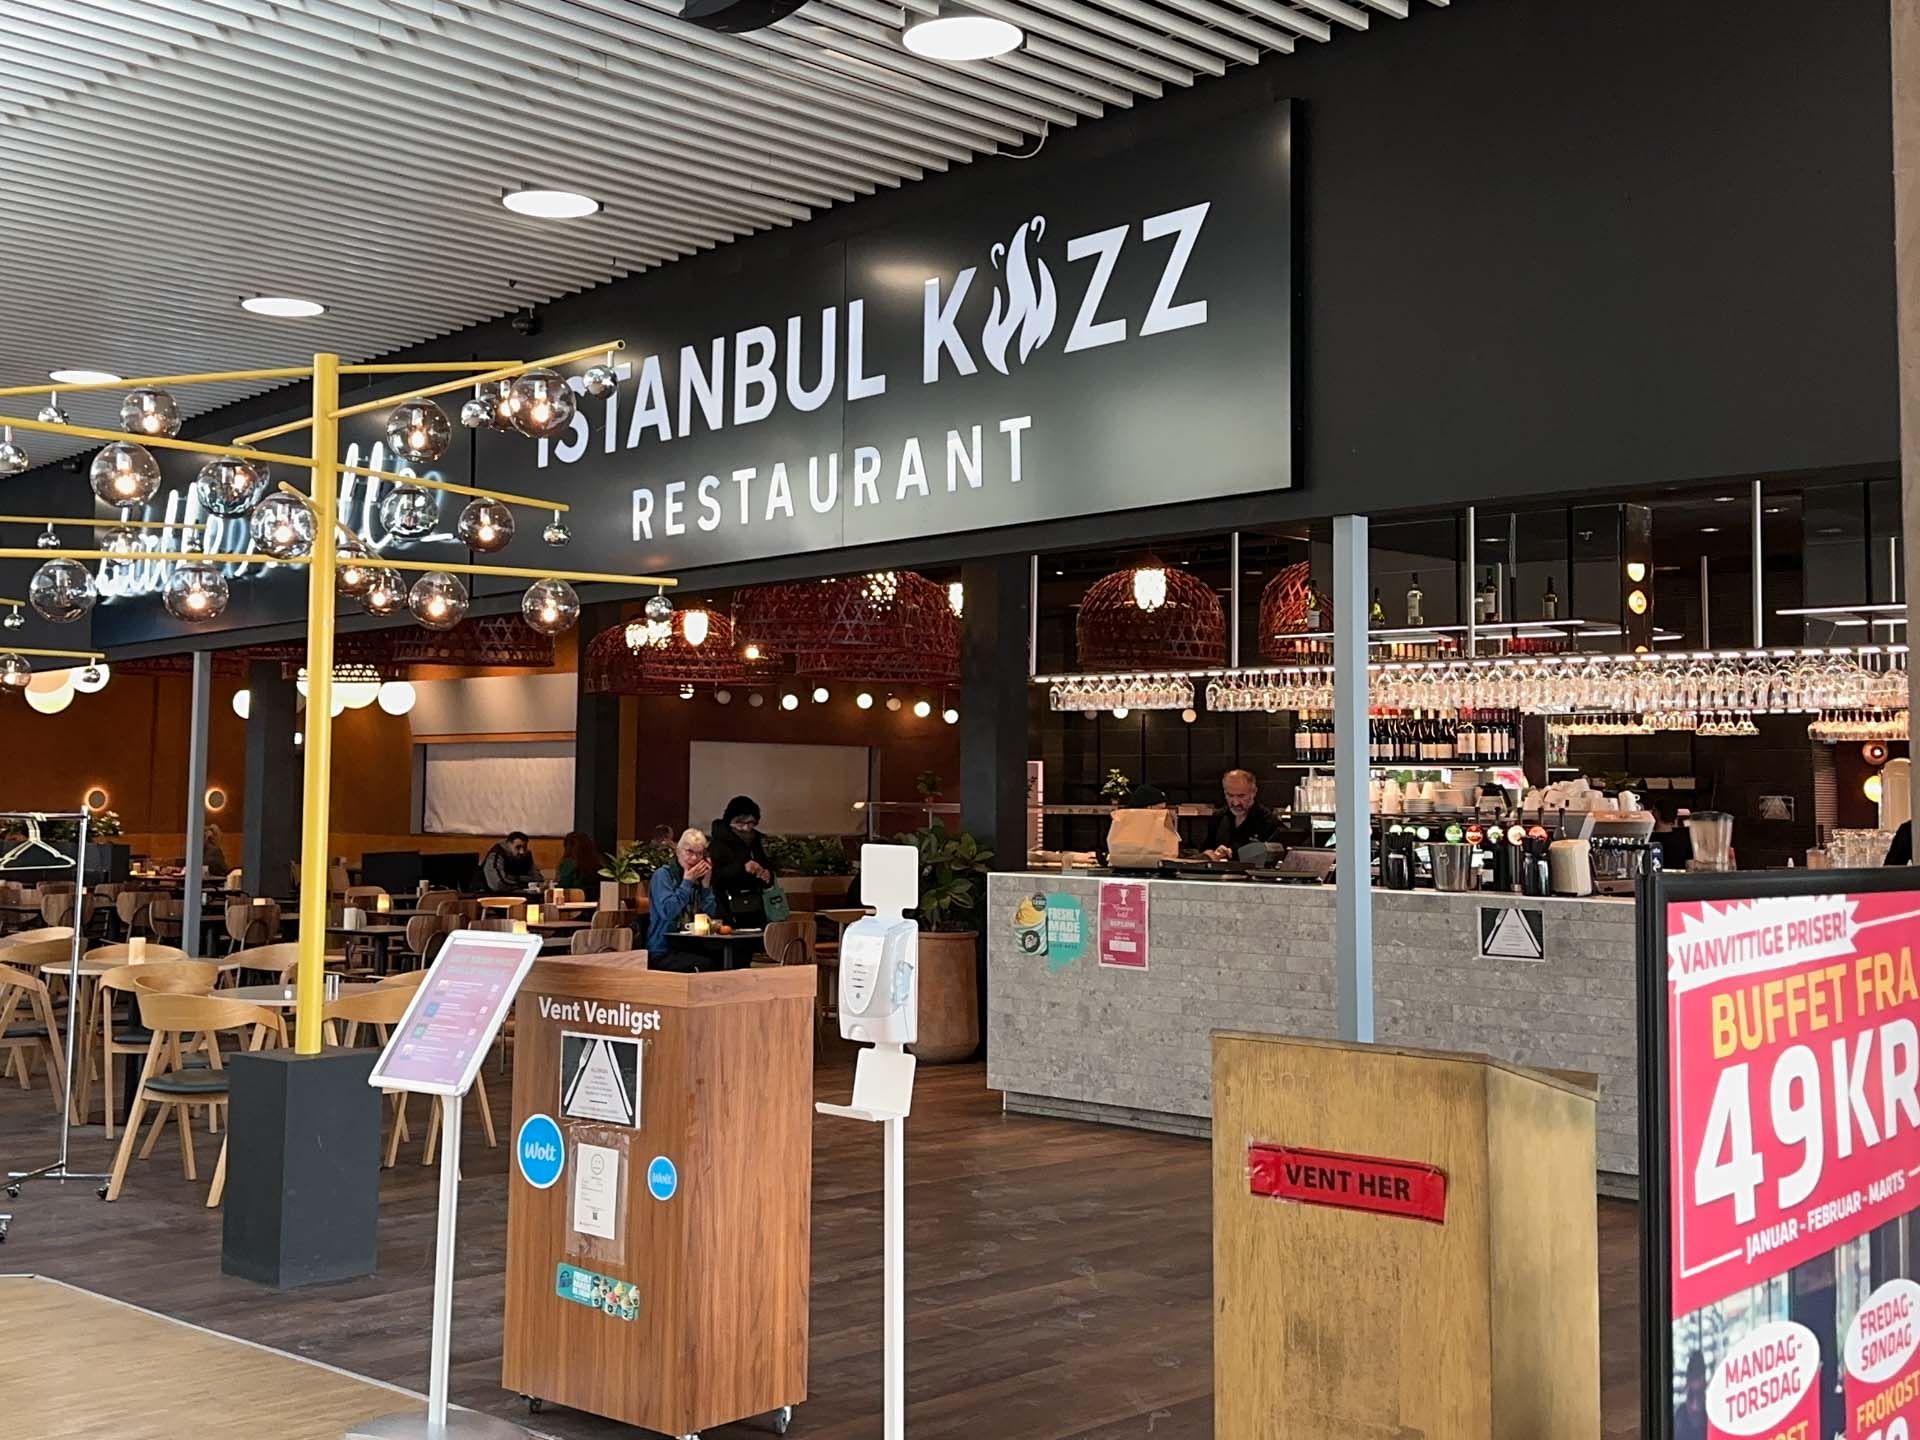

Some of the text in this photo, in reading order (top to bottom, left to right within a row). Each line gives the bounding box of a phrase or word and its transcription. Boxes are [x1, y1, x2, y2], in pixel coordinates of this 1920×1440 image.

[631, 416, 1032, 542] RESTAURANT
[1678, 909, 1847, 975] VANVITTIGE PRISER!
[539, 996, 661, 1035] Vent Venligst
[1711, 946, 1920, 1060] BUFFET FRA
[525, 1141, 557, 1162] Wolt
[1284, 1163, 1411, 1201] VENT HER
[1746, 1218, 1799, 1264] JANUAR
[1807, 1191, 1862, 1232] FEBRUAR
[1868, 1169, 1905, 1205] MARTS
[1860, 1293, 1914, 1339] FREDAG-
[1725, 1334, 1802, 1388] MANDAG-
[1725, 1366, 1801, 1423] TORSDAG
[1856, 1370, 1920, 1433] FROKOST
